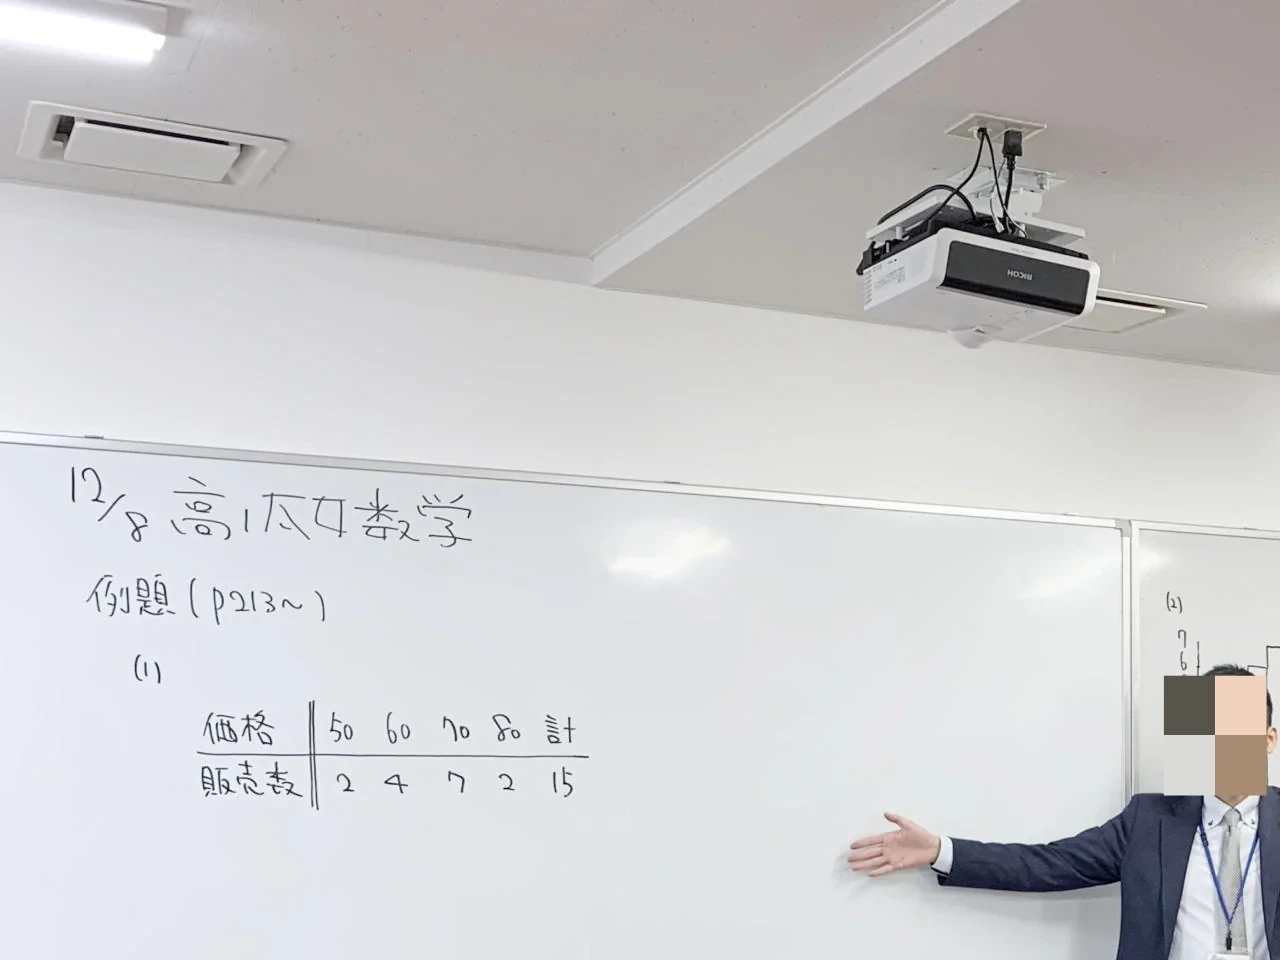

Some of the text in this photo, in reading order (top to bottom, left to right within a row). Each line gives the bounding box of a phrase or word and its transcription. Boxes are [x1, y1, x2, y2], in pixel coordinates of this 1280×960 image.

[1007, 269, 1033, 281] RICOH
[1166, 591, 1183, 614] (2)
[1178, 629, 1187, 648] 7
[134, 654, 161, 684] (1)
[1180, 651, 1188, 671] 6
[203, 710, 576, 746] 価格 50 60 70 80 計
[336, 773, 355, 793] 2
[384, 774, 408, 794] 4
[448, 771, 465, 793] 7
[499, 773, 515, 792] 2
[553, 771, 573, 797] 15
